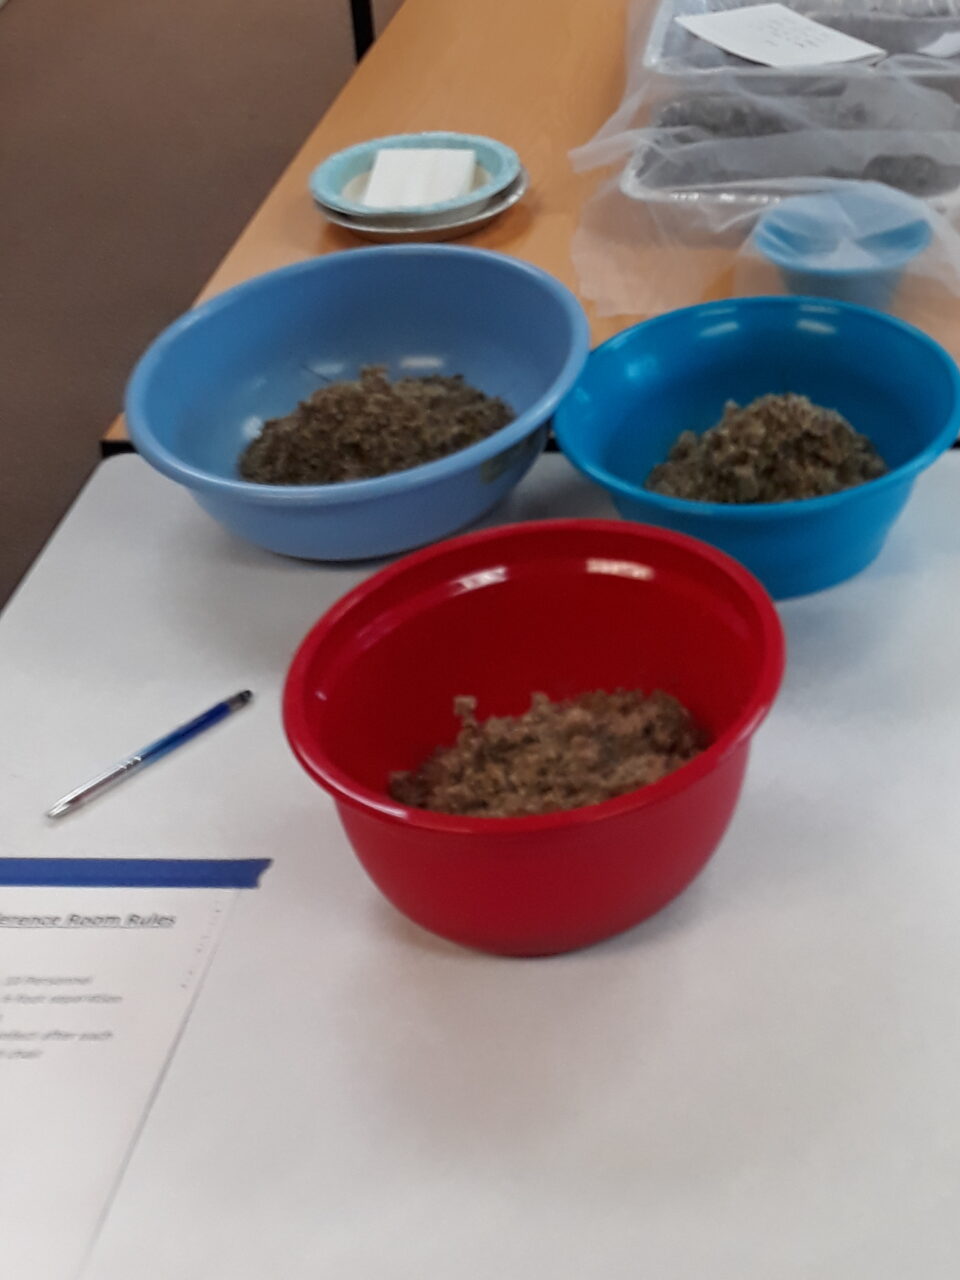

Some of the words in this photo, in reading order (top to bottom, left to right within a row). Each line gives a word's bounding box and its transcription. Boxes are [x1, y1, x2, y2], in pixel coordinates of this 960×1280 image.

[0, 913, 61, 927] erence
[67, 913, 122, 927] Room
[126, 912, 176, 928] Rules
